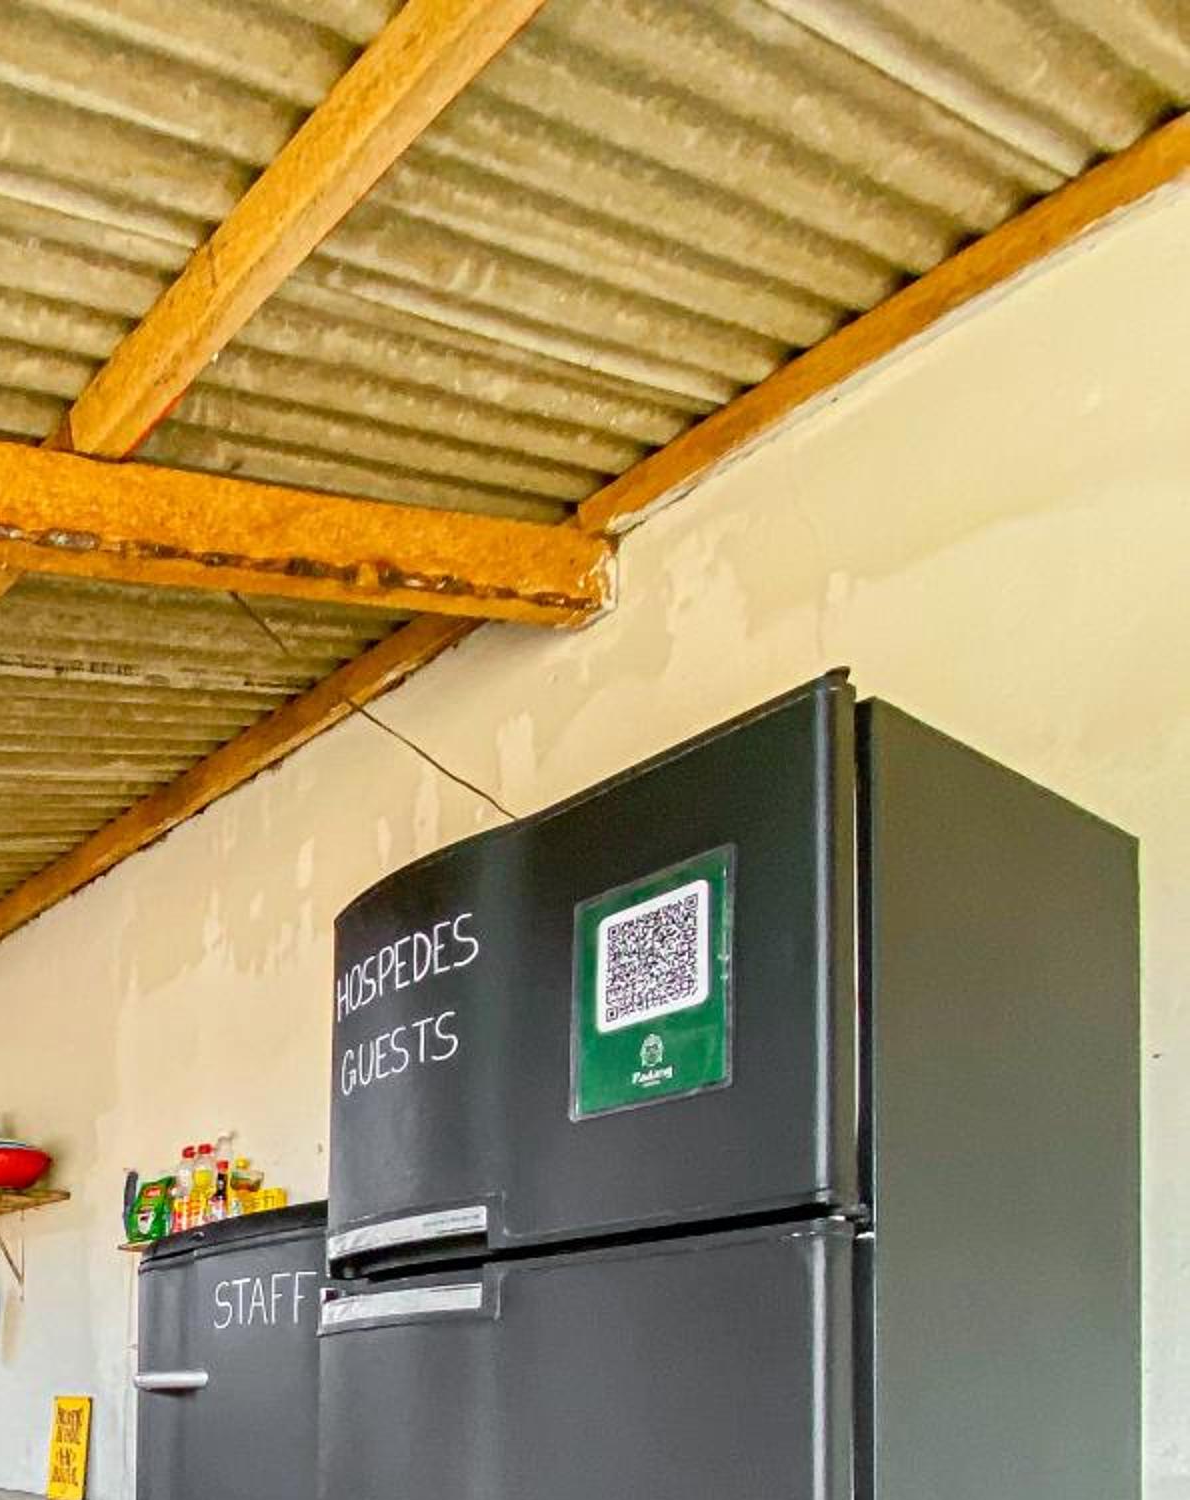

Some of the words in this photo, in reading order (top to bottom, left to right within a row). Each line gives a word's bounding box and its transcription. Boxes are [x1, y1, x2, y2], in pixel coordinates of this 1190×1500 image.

[336, 912, 480, 1023] HOSPEDES
[340, 1010, 459, 1096] GUESTS
[213, 1271, 318, 1329] STAFF
